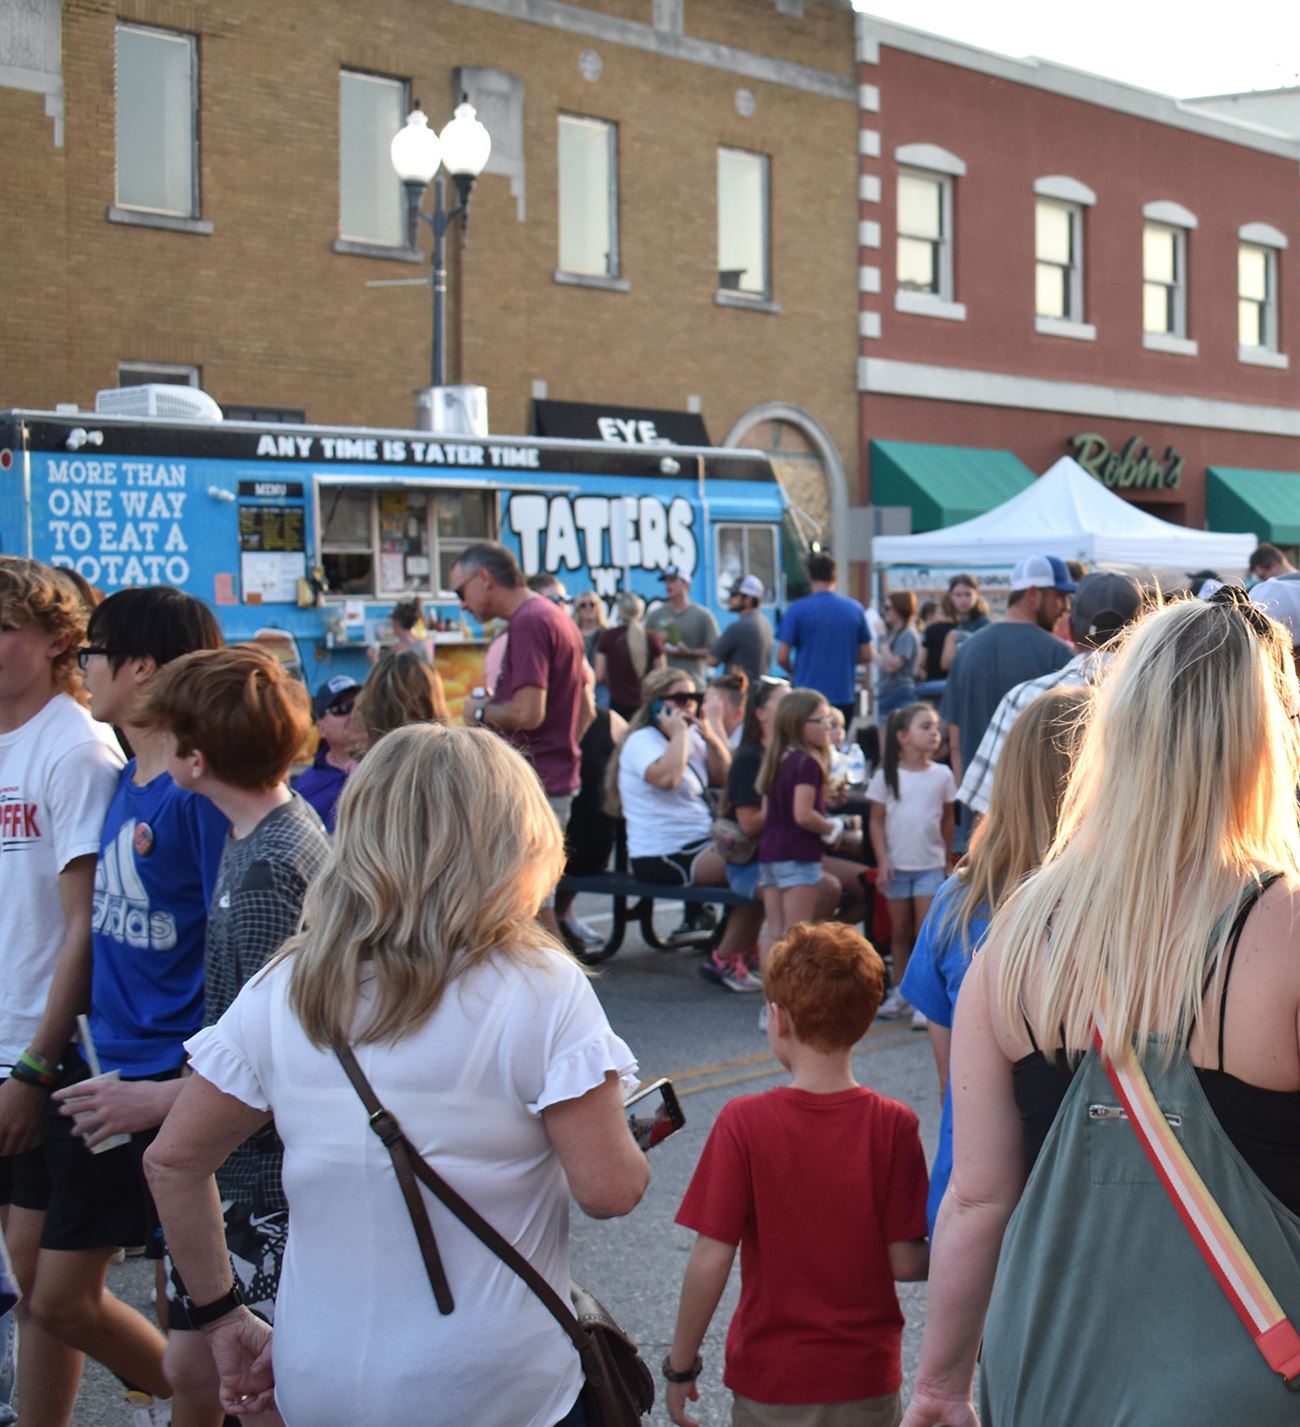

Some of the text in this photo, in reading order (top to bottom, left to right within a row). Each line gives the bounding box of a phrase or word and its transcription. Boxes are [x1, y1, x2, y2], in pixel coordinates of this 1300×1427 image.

[597, 416, 658, 445] EYE
[256, 433, 540, 468] ANY TIME IS TATER TIME
[1070, 432, 1184, 488] Robin's
[47, 459, 187, 487] MORE THAN
[254, 482, 287, 497] MENU
[48, 488, 187, 519] ONE WAY
[49, 520, 188, 552] TO EAT A
[510, 494, 697, 578] TATERS
[0, 803, 42, 838] FFK
[92, 891, 178, 951] didas
